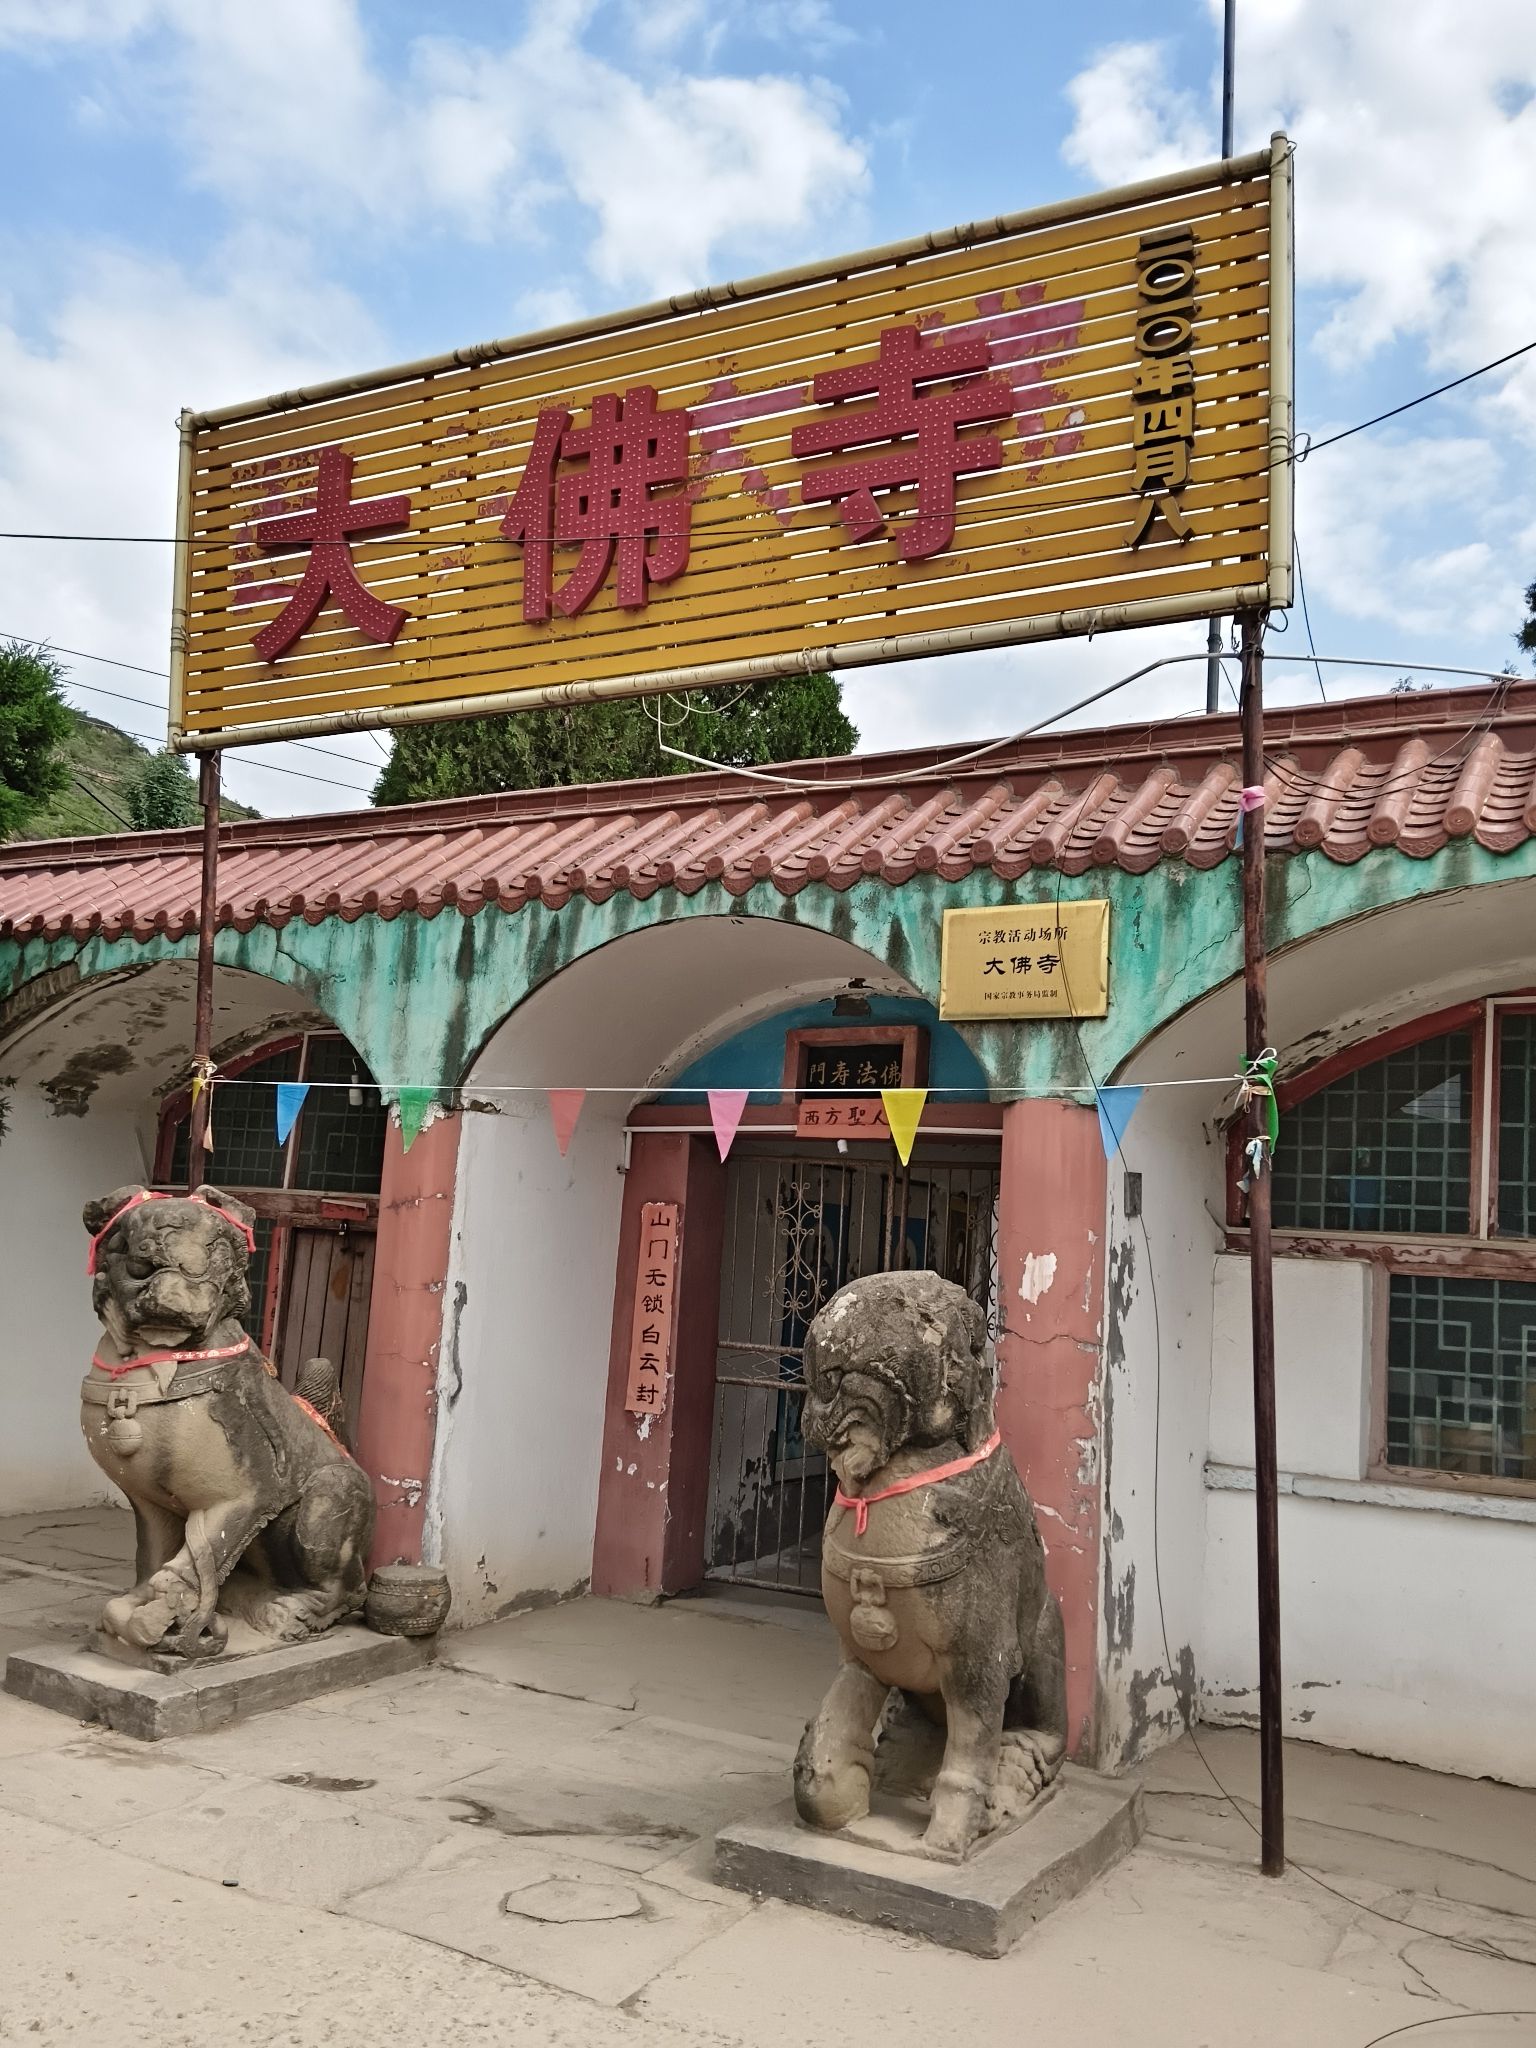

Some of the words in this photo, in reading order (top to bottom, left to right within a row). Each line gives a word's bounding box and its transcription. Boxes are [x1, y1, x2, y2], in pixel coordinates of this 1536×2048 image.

[978, 926, 1069, 945] 宗教活动场所
[983, 953, 1061, 975] 大佛寺
[984, 989, 1058, 1001] 国家宗教事务局监制
[636, 1211, 671, 1405] 山门无锁白云封
